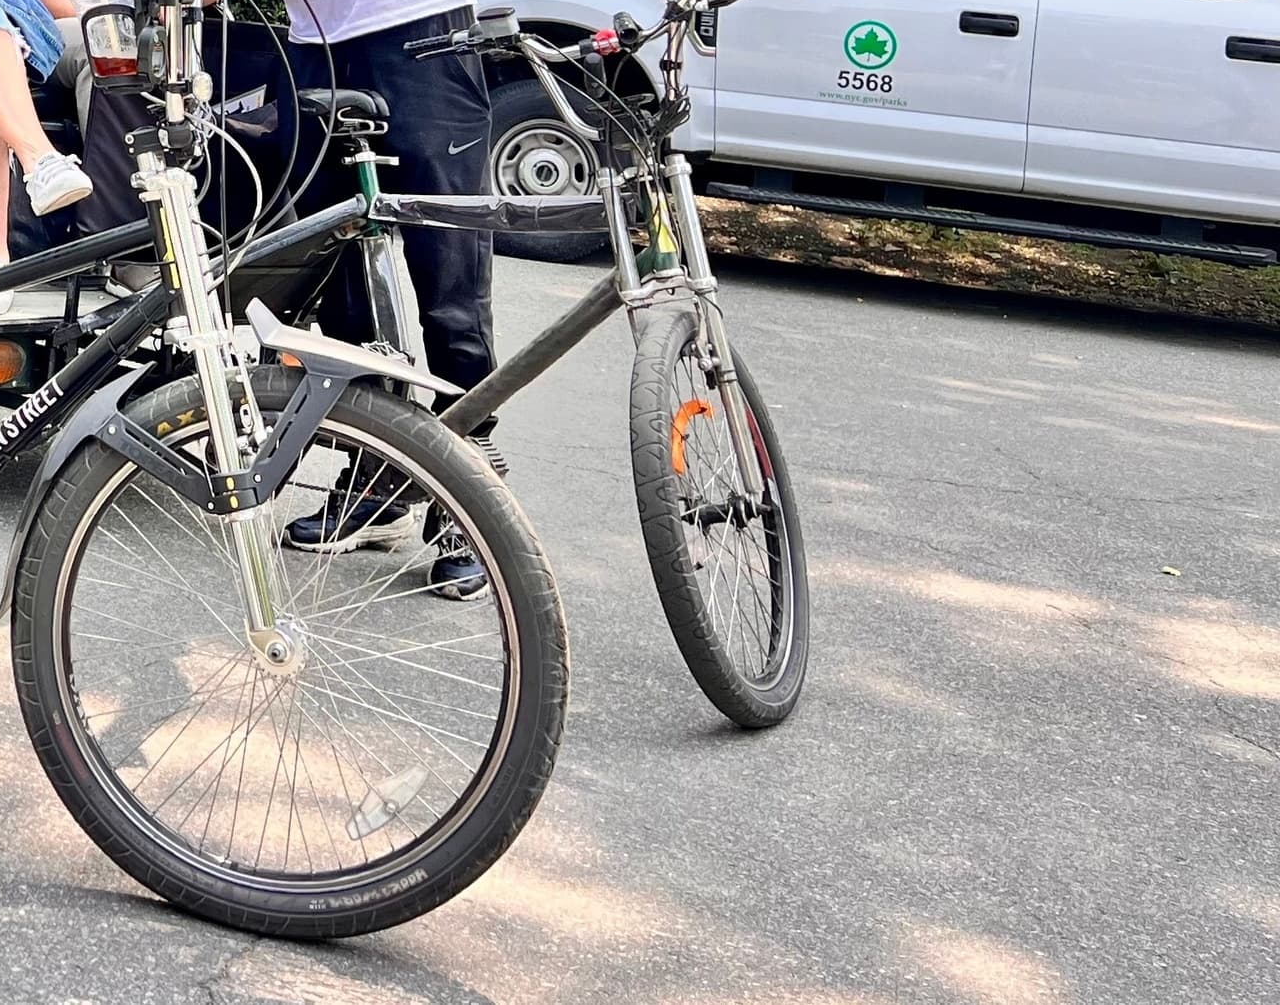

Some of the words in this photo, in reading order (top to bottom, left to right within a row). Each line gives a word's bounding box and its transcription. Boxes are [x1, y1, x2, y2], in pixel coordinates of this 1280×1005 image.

[837, 70, 893, 93] 5568
[818, 91, 908, 107] www.nyc.gov/parks
[2, 377, 64, 438] STREET
